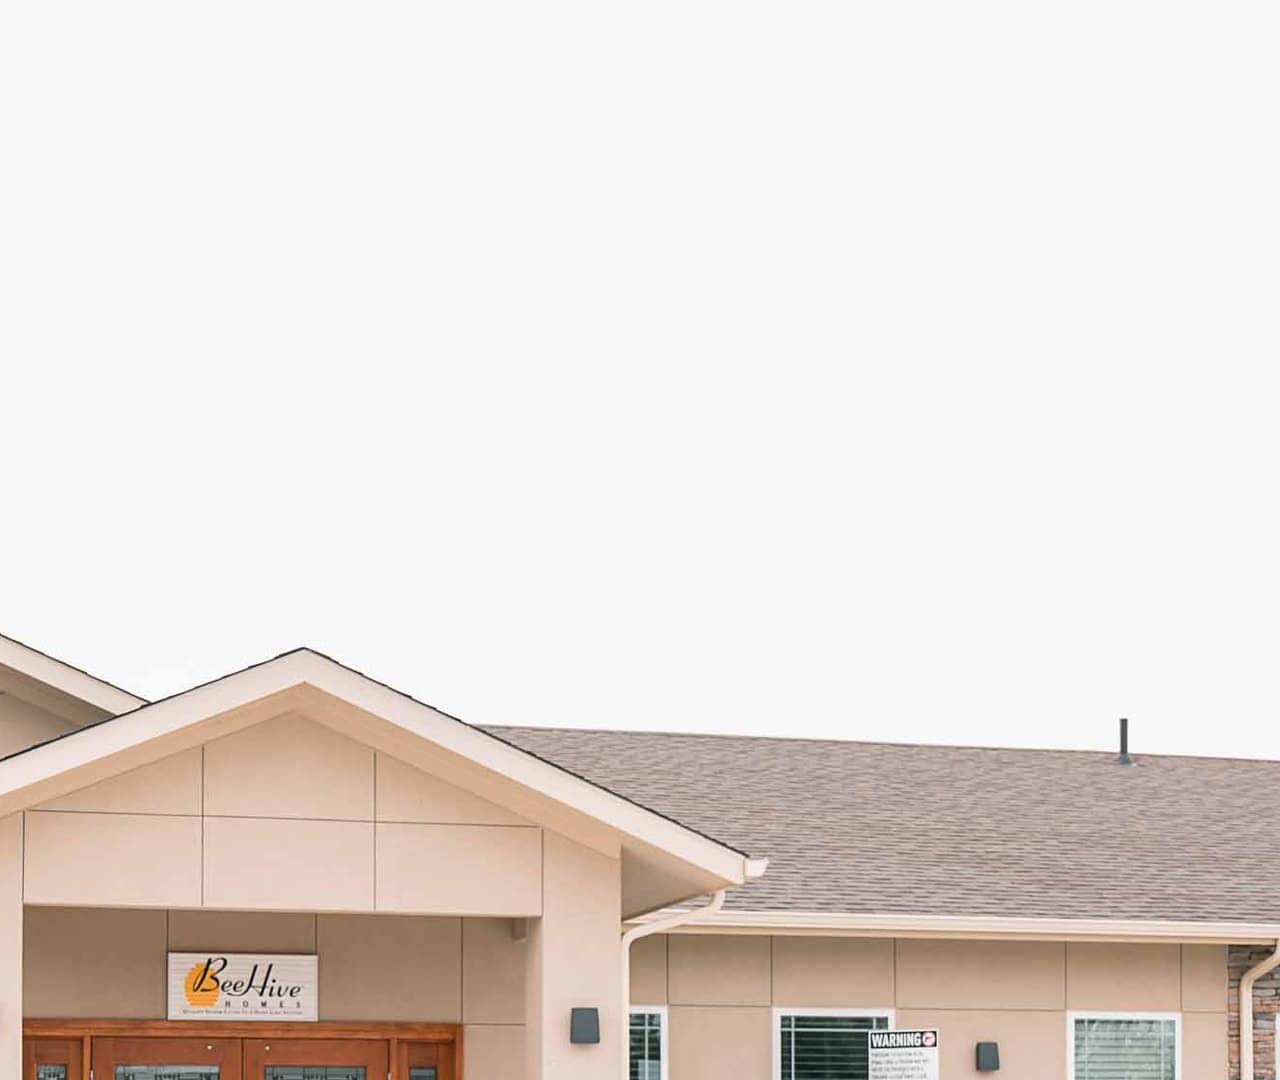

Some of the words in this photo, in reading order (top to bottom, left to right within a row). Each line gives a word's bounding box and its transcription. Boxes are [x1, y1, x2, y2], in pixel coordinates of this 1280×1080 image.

[192, 957, 302, 998] BeeHive
[224, 1000, 302, 1009] HOMES
[871, 1032, 921, 1048] WARNING
